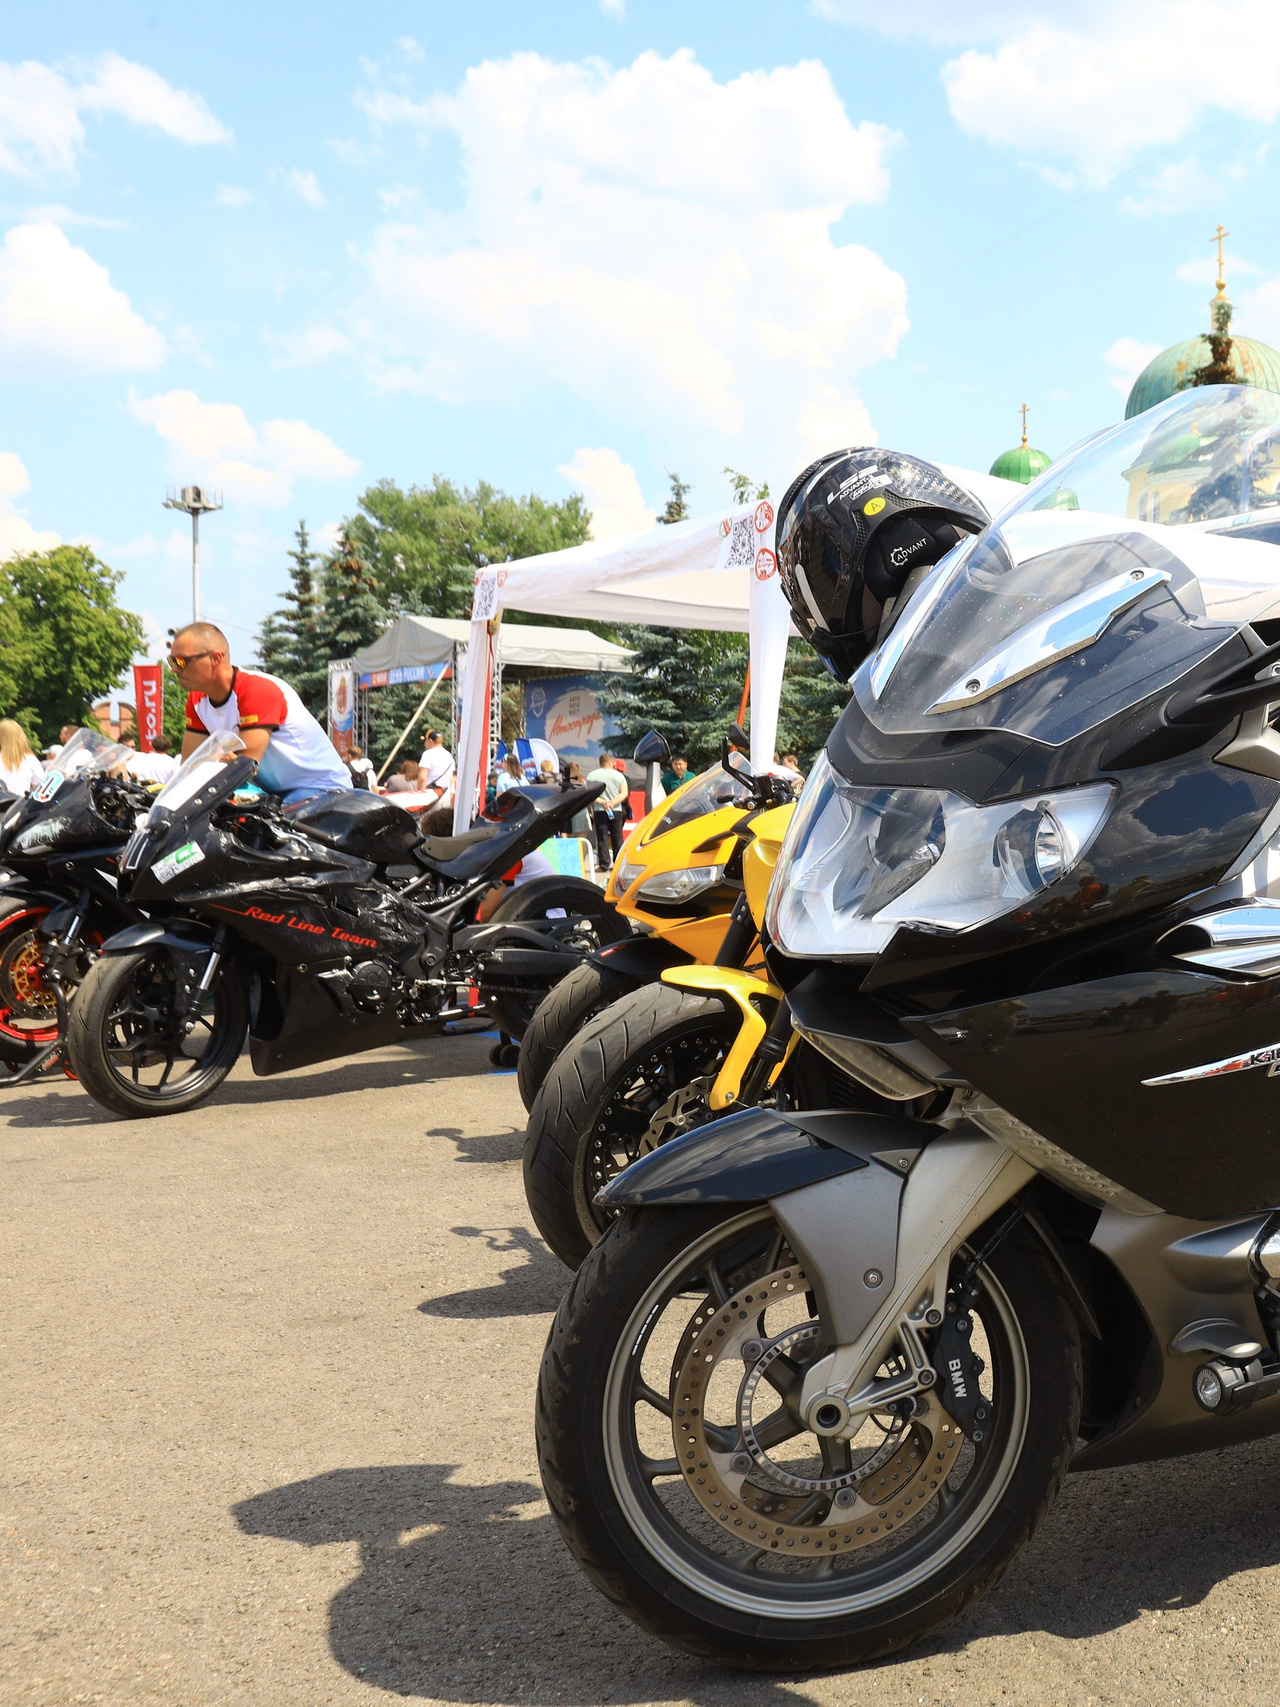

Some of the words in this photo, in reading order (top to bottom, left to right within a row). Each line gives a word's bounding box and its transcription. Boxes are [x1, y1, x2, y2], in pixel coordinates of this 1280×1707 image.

[896, 537, 928, 561] ADVANT
[143, 680, 157, 742] to.ru
[244, 906, 286, 924] Red
[288, 916, 327, 935] Line
[331, 927, 378, 948] Team
[948, 1358, 968, 1398] BMW
